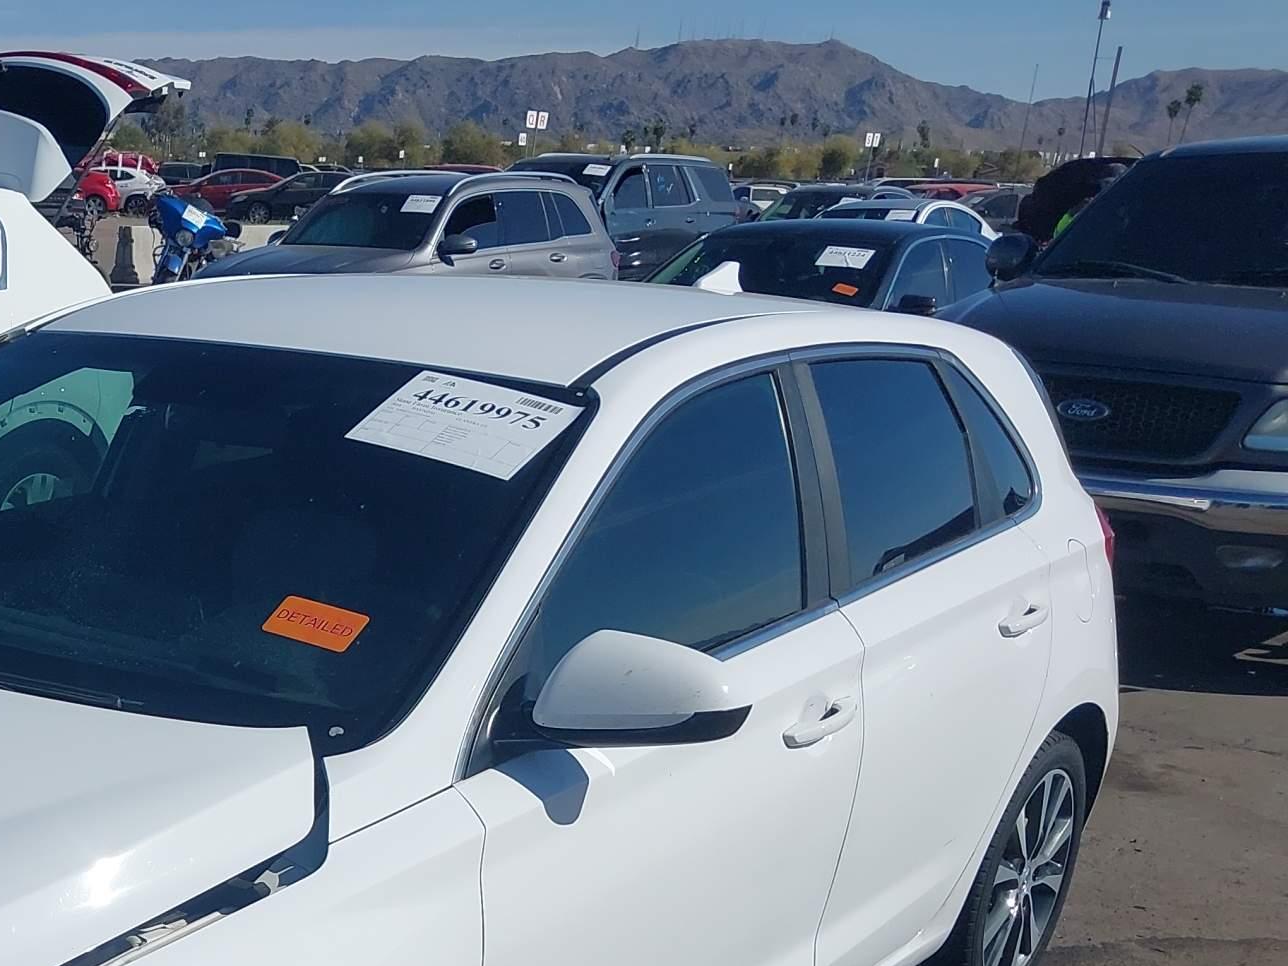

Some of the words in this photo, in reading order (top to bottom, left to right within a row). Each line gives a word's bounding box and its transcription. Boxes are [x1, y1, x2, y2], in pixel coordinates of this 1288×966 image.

[528, 114, 535, 126] Q
[539, 115, 546, 127] R
[412, 388, 547, 430] 44619975
[1067, 402, 1098, 417] Ford
[277, 608, 353, 638] DETAILED
